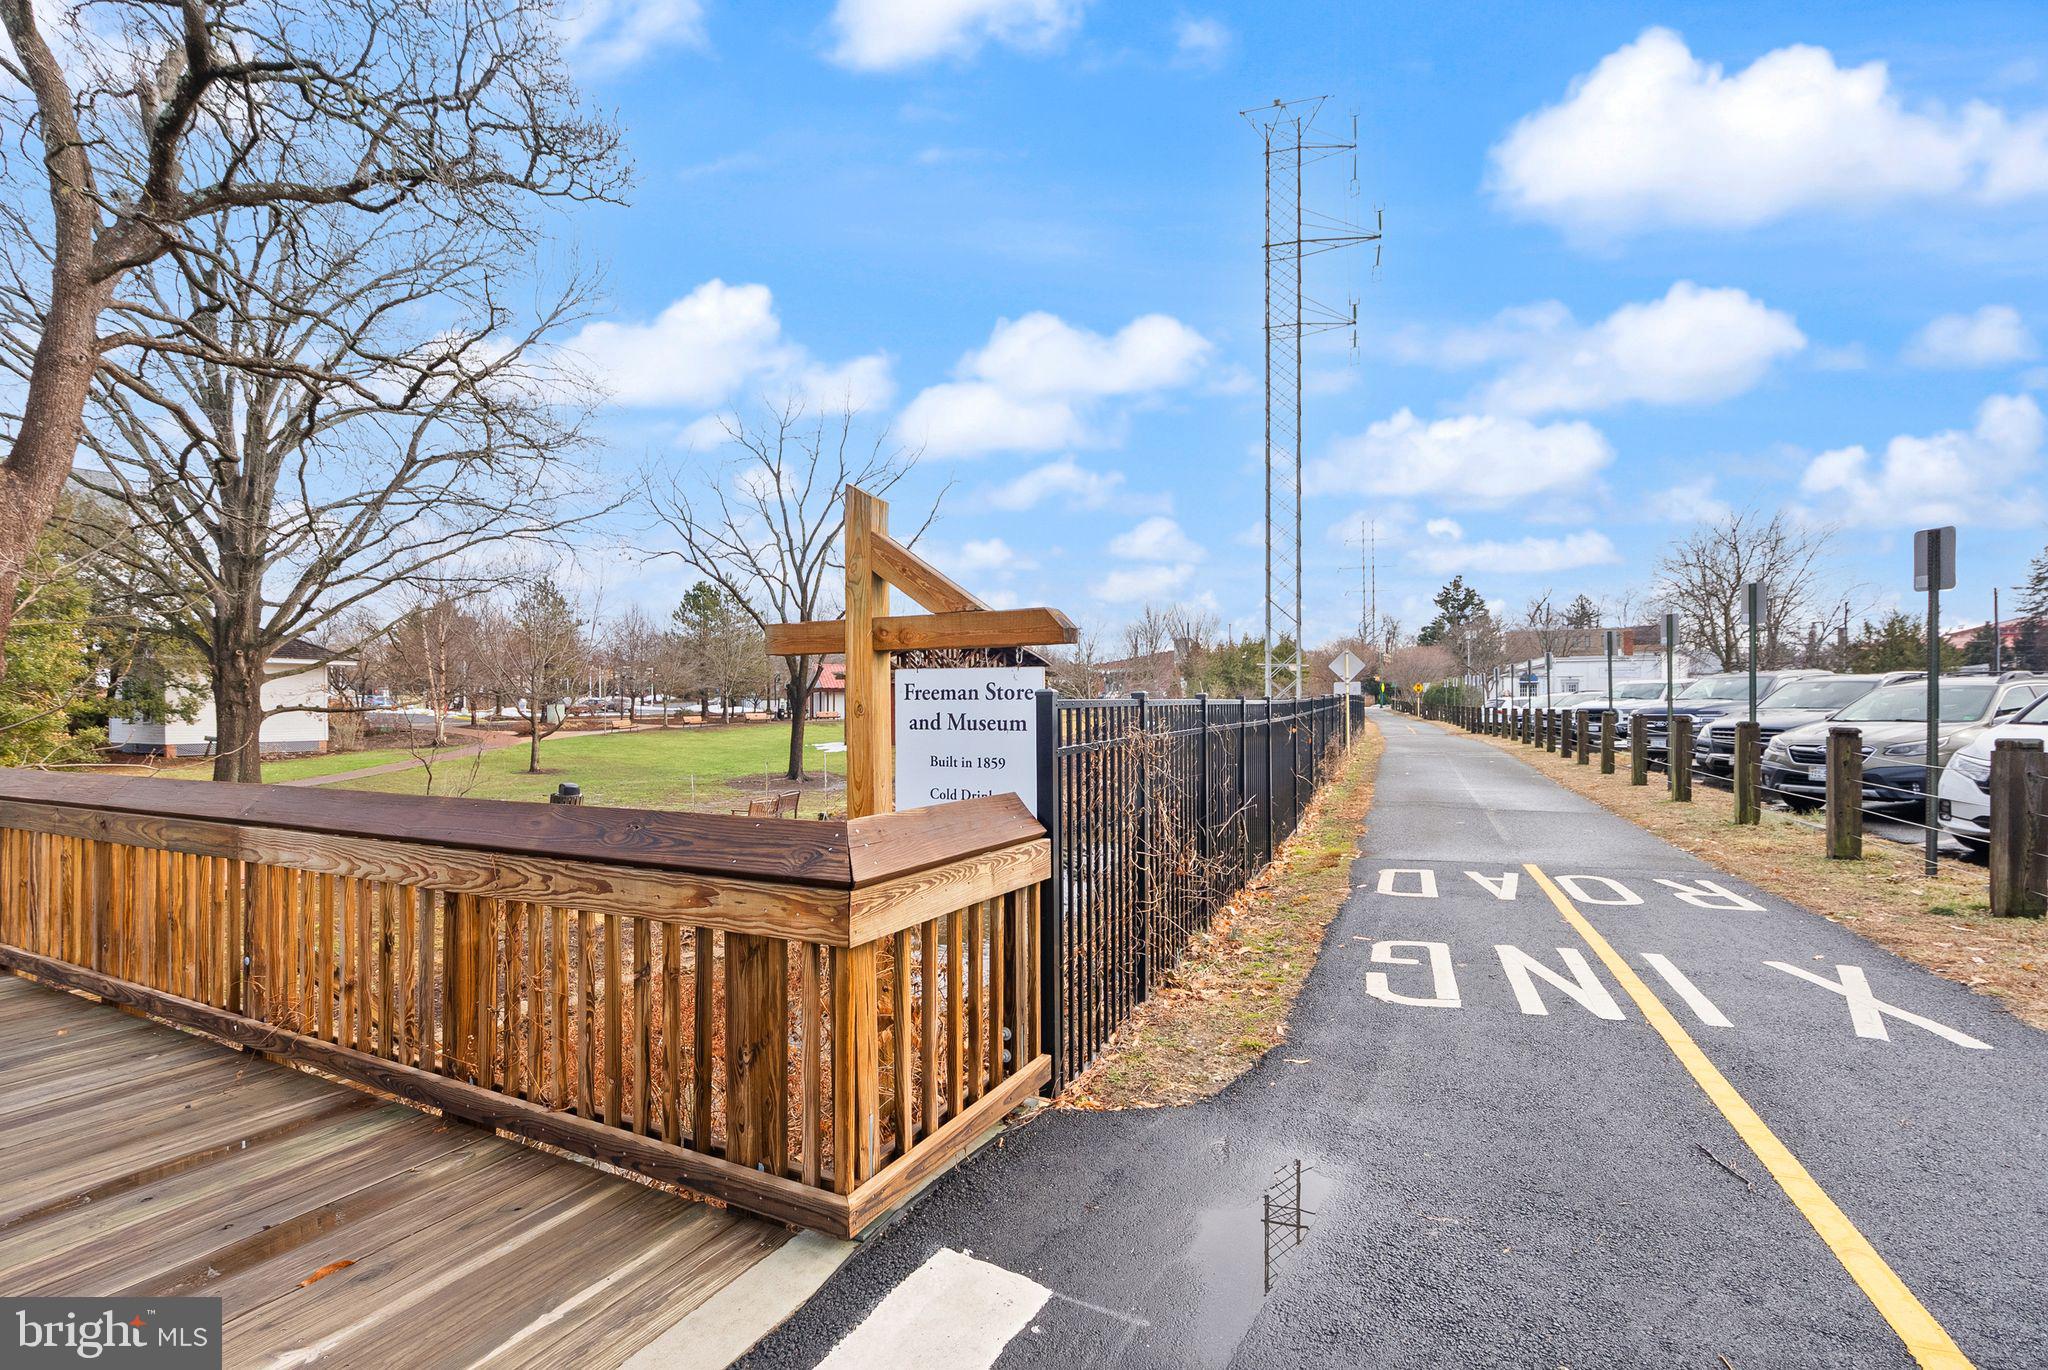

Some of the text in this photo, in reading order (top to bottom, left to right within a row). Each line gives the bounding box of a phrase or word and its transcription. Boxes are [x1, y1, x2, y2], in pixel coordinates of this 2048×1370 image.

[904, 681, 1034, 701] Freeman Store
[909, 711, 1028, 732] and Museum
[930, 755, 1006, 770] Built in 1859
[930, 787, 957, 800] Cold
[1375, 868, 1768, 912] ROAD
[1366, 940, 1994, 1050] XING
